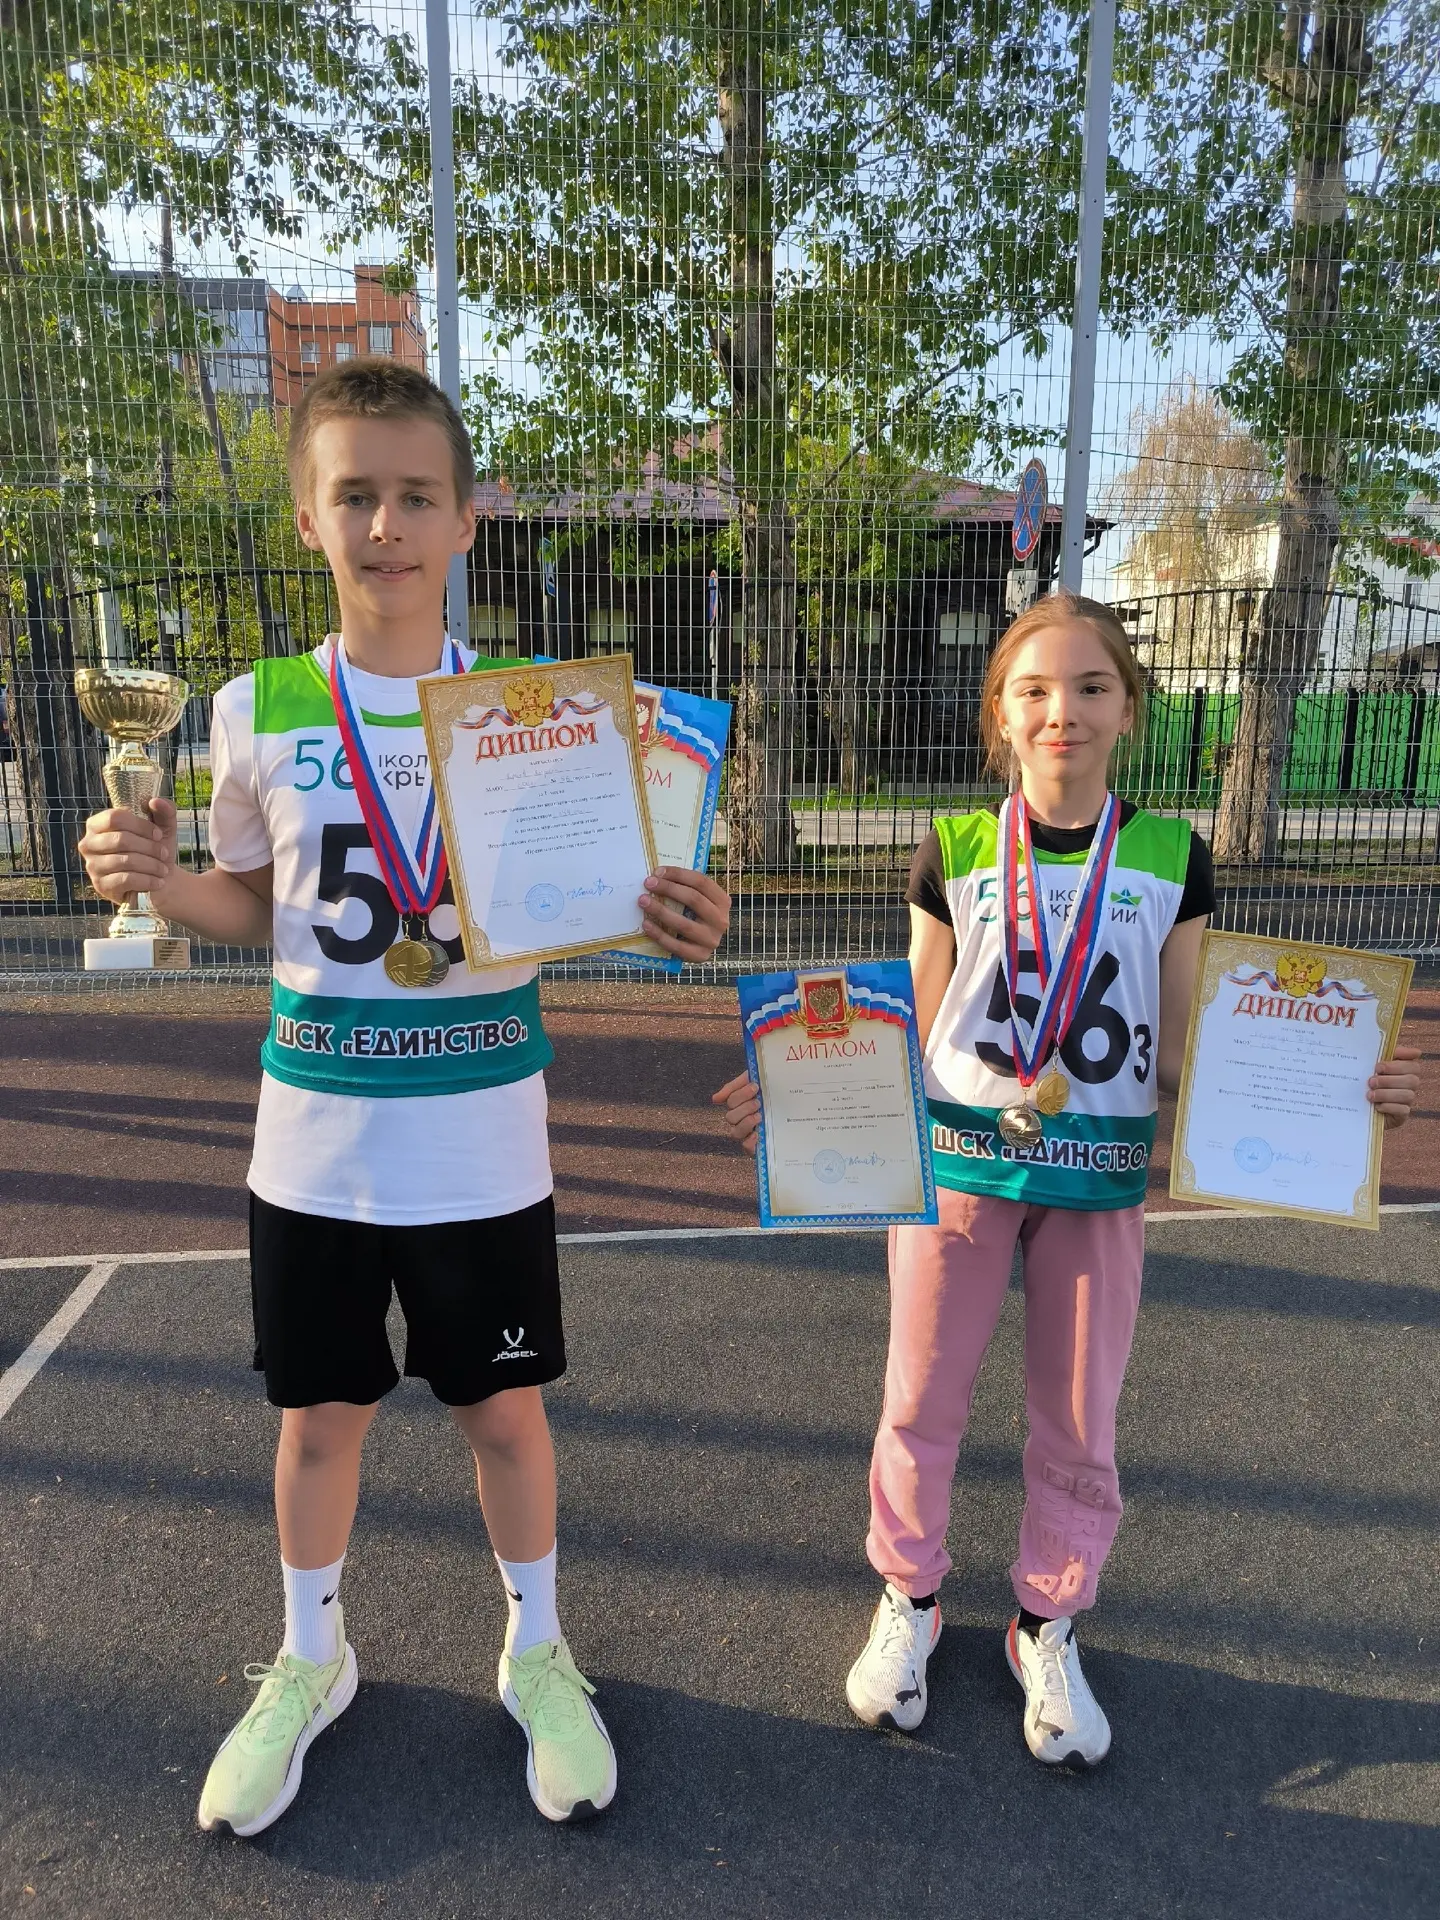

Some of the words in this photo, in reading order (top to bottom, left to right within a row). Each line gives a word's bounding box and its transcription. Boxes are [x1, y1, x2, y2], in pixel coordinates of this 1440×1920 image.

[475, 721, 599, 765] ДИПЛОМ
[975, 950, 1130, 1085] 56
[1232, 992, 1358, 1029] ДИПЛОМ
[277, 1014, 334, 1054] ШСК
[786, 1039, 876, 1061] ДИПЛОМ
[933, 1124, 995, 1159] ШСК
[492, 1350, 538, 1362] JÖGEL
